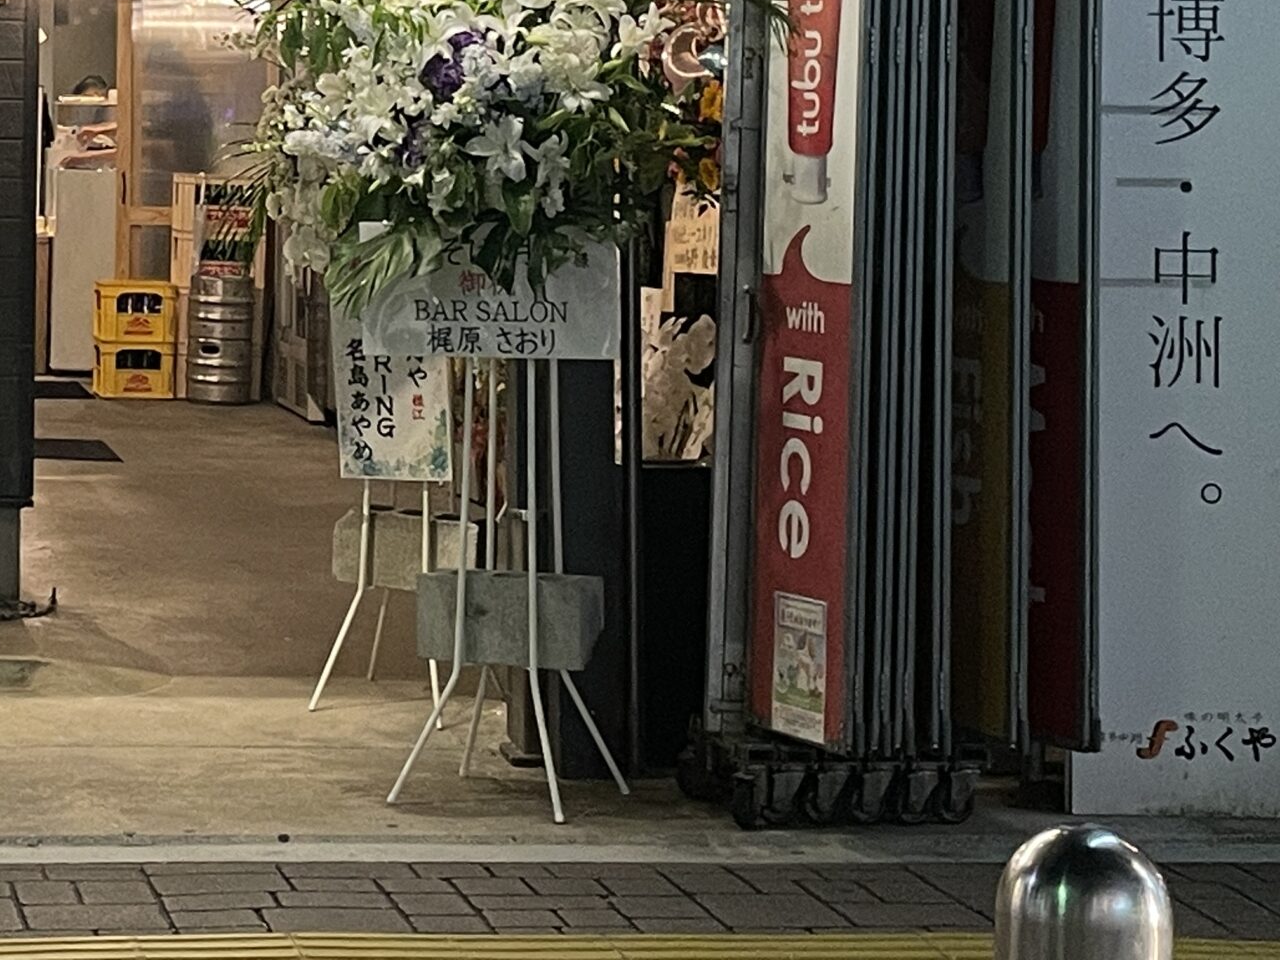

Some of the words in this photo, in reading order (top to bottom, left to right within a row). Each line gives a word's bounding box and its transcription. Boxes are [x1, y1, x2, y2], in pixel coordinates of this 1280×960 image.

[791, 30, 822, 137] tubu
[414, 298, 469, 322] BAR
[476, 300, 568, 323] SALON
[785, 302, 825, 334] with
[778, 356, 823, 559] Rice
[1174, 724, 1277, 763] ふくや
